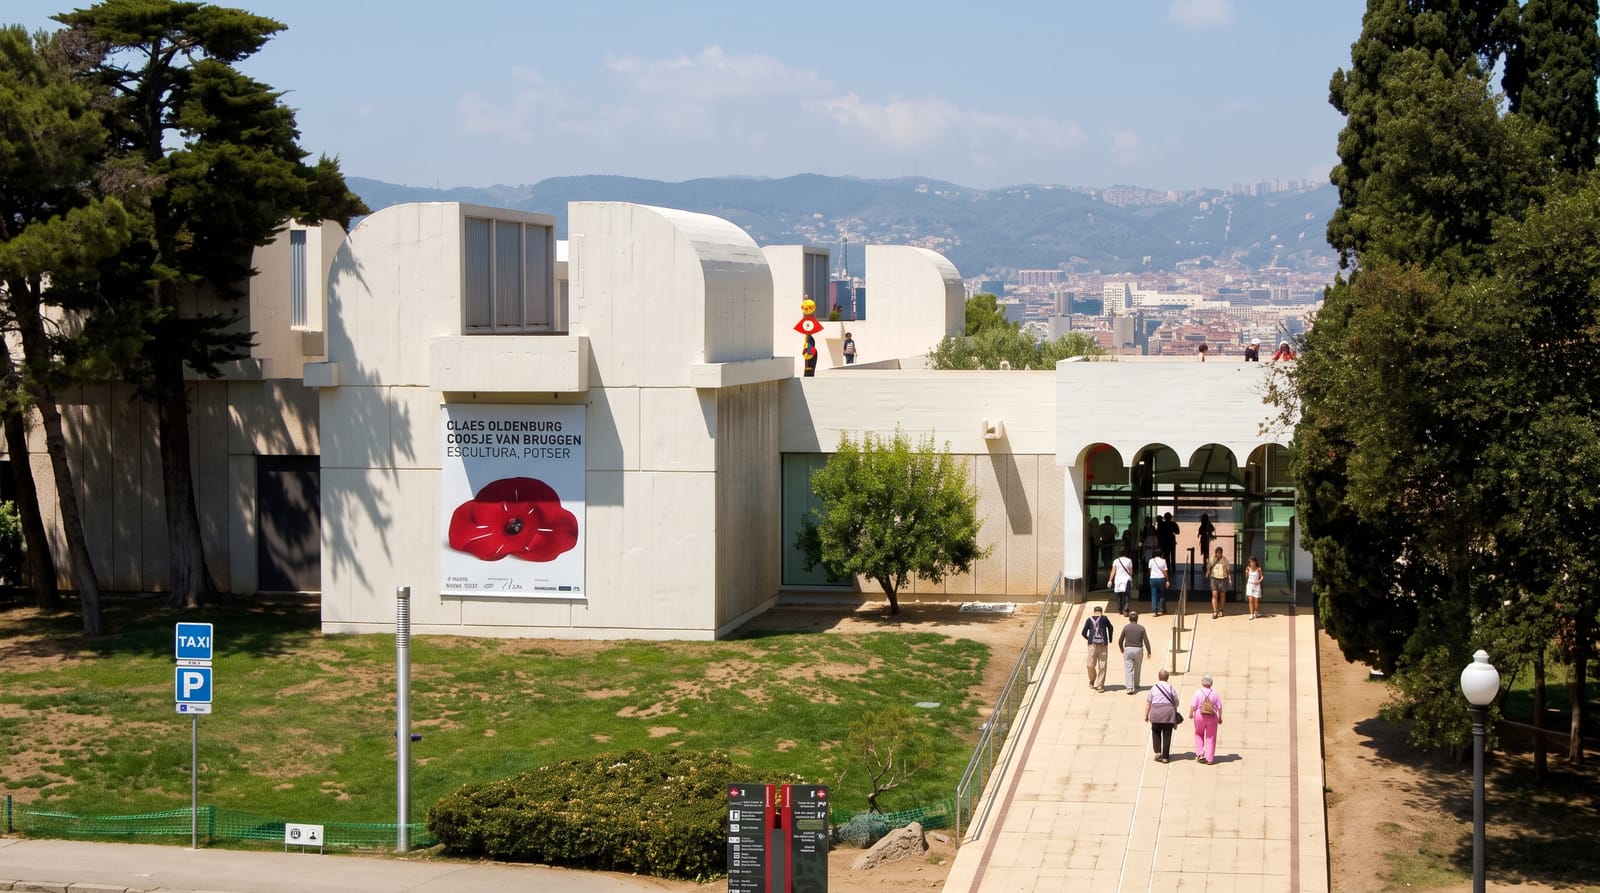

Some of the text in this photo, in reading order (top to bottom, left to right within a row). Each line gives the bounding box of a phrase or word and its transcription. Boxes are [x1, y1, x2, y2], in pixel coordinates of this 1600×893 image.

[447, 420, 562, 432] CLAES OLDENBURG
[447, 433, 582, 446] COOSJE VAN BRUGGEN
[447, 447, 571, 459] ESCULTURA, POTSER
[178, 635, 210, 649] TAXI
[183, 671, 205, 698] P
